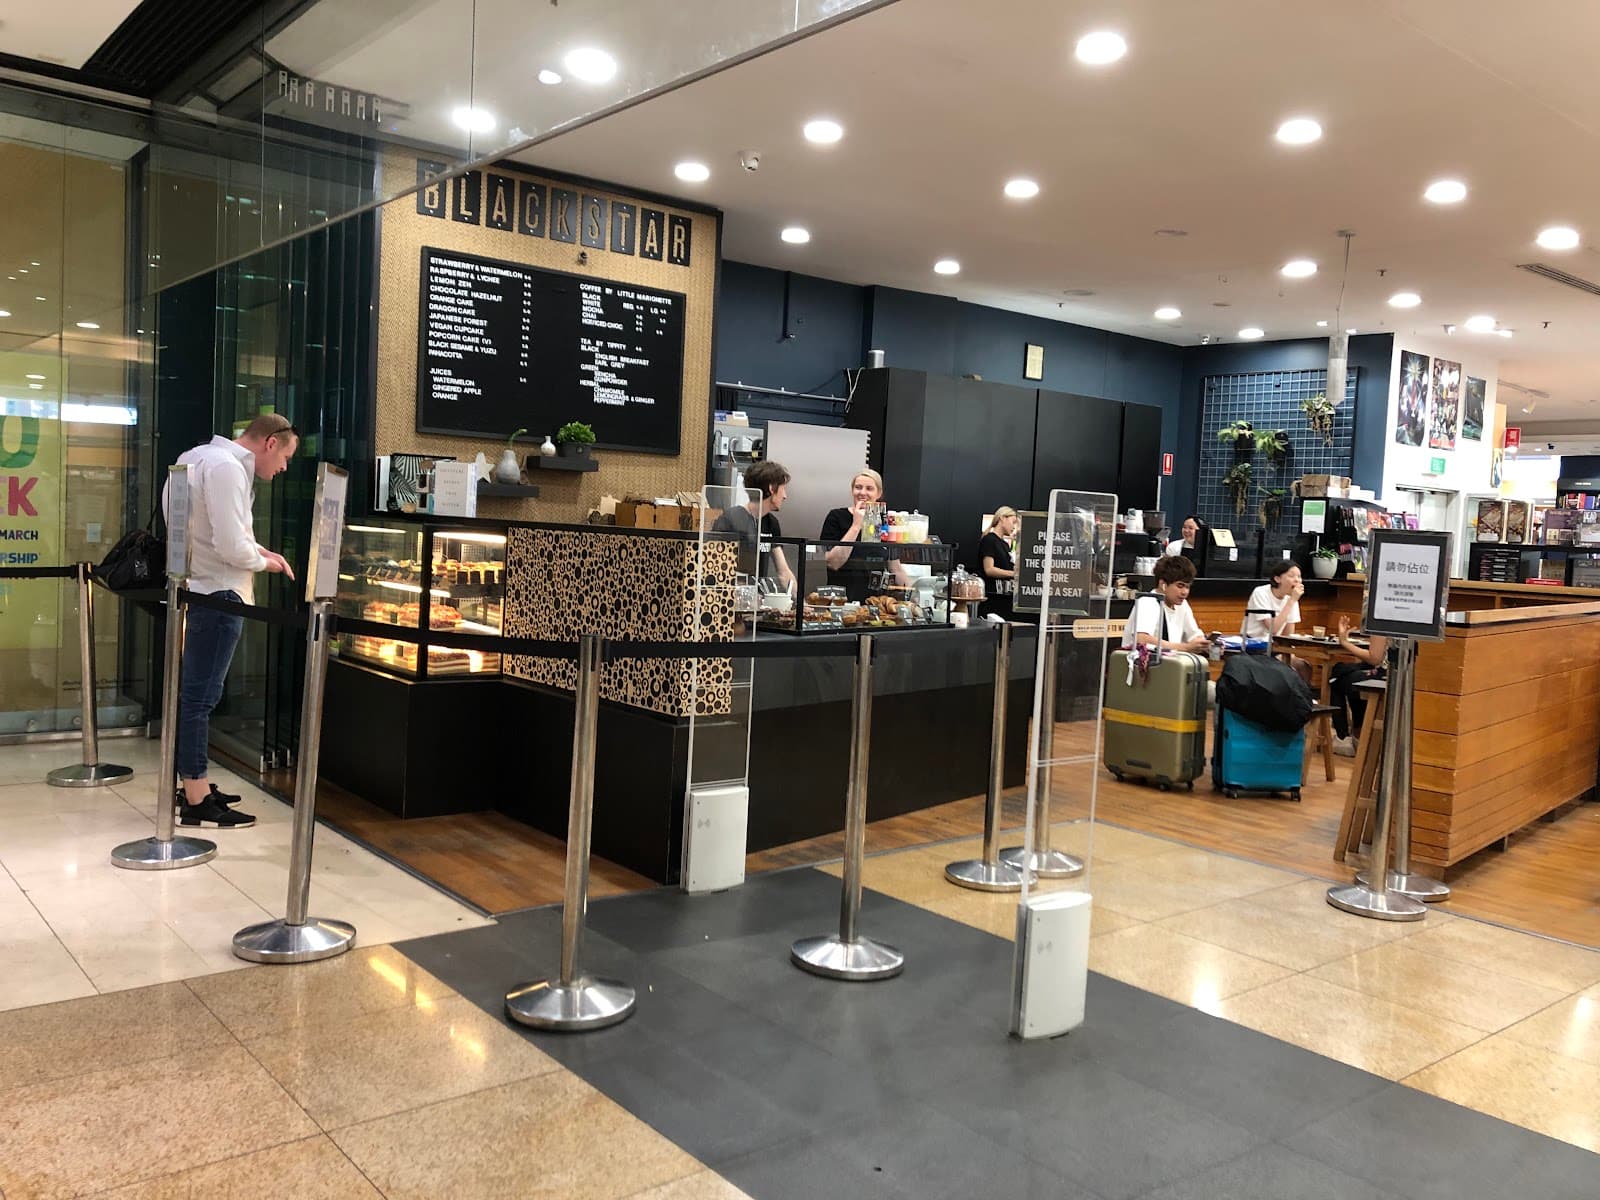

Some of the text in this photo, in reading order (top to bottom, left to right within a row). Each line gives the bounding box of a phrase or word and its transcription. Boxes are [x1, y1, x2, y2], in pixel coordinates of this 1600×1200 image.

[430, 257, 474, 270] STRAWBERRY
[480, 266, 522, 278] WATERMELON
[430, 267, 469, 279] RASPBERRY
[477, 275, 500, 284] LYCHEE
[430, 276, 472, 288] LEMON ZEN
[430, 285, 502, 301] CHOCOLATE HAZELNUT
[580, 283, 601, 293] COFFEE
[617, 290, 634, 299] LITTLE
[637, 294, 671, 305] MARIONETTE
[582, 293, 601, 301] BLACK
[430, 294, 455, 304] ORANGE
[582, 299, 600, 307] WHITE
[429, 303, 475, 316] DRAGON CAKE
[582, 306, 604, 314] MOCHA
[429, 312, 487, 326] JAPANESE FOREST
[429, 321, 484, 336] VEGAN CUPCAKE
[429, 331, 460, 341] POPCORN
[462, 335, 479, 343] CAKE
[428, 340, 449, 348] BLACK
[450, 343, 473, 351] SESAME
[595, 353, 649, 366] ENGLISH BREAKFAST
[430, 368, 452, 376] JUICES
[433, 376, 475, 386] WATERMELON
[594, 376, 628, 385] GUNPOWDER
[432, 384, 462, 393] GINGERED
[594, 386, 624, 394] CHAMOMILE
[432, 392, 457, 400] ORANGE
[0, 529, 38, 541] MARCH
[1033, 545, 1074, 555] ORER AT
[1025, 559, 1040, 568] THE
[1036, 573, 1069, 582] BFORE
[1055, 587, 1062, 596] A
[1063, 588, 1083, 597] SEAT
